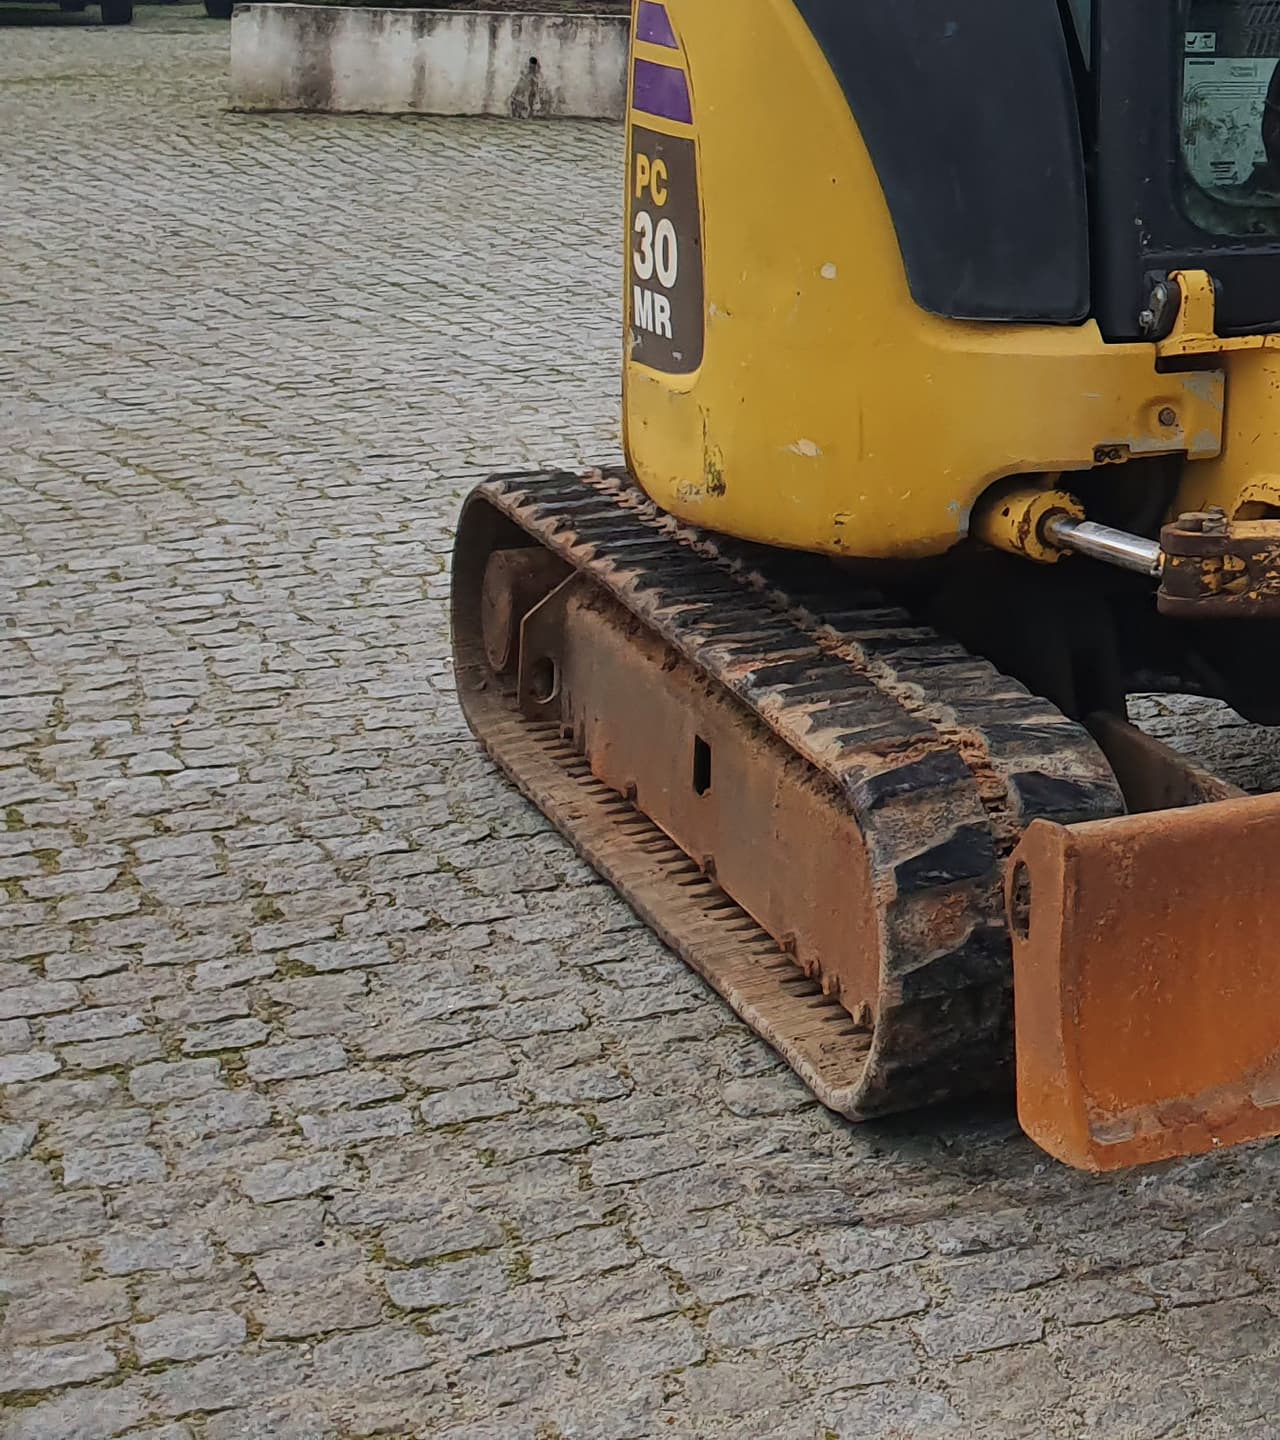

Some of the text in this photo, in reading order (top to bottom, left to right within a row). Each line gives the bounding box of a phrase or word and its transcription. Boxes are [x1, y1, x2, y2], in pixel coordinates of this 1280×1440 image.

[635, 152, 668, 207] PC
[633, 210, 678, 289] 30
[633, 284, 673, 339] MR
